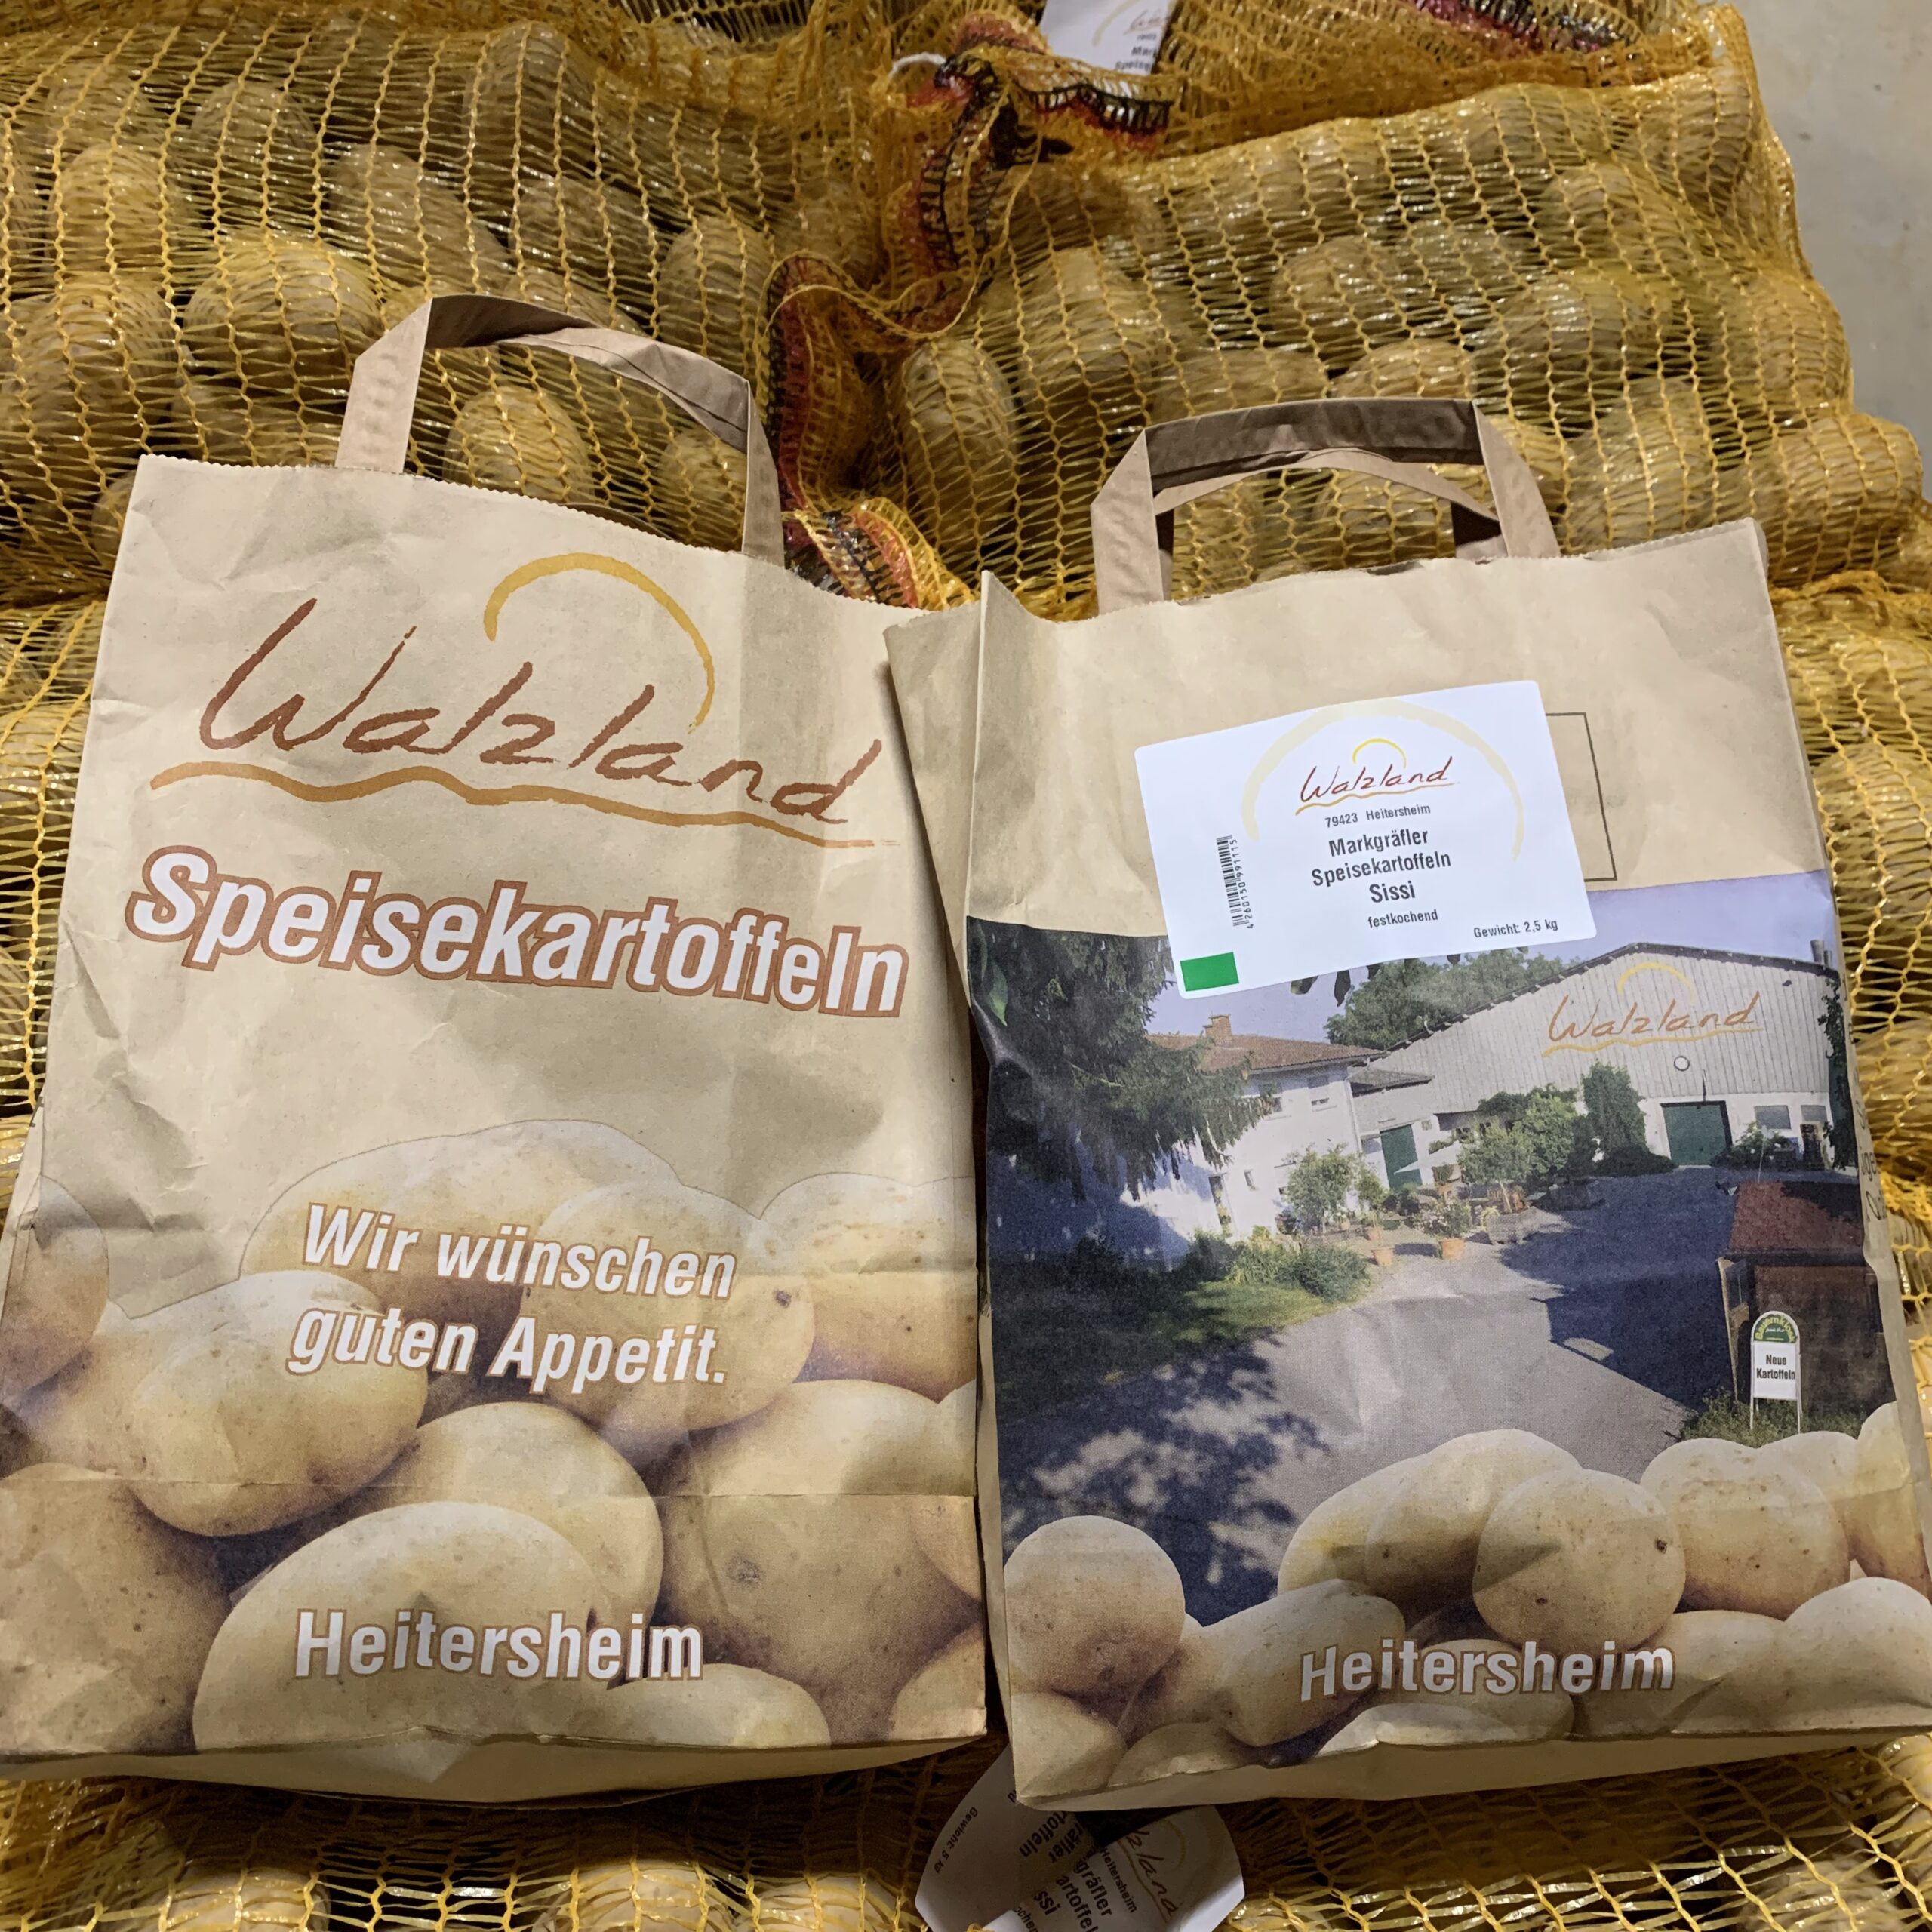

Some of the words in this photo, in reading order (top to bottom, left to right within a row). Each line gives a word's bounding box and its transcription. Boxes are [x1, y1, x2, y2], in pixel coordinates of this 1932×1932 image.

[199, 598, 882, 824] Walzland
[1300, 756, 1452, 803] Walzland
[1324, 812, 1358, 828] 79423
[1366, 804, 1431, 820] Heitersheim
[1328, 829, 1429, 857] Markgräfler
[1312, 851, 1451, 887] Speisekartoffeln
[1369, 881, 1416, 903] Sissi
[128, 845, 908, 1018] Speisekartoffeln
[1367, 909, 1438, 928] festkochend
[1473, 923, 1520, 938] Gewicht:
[1524, 921, 1541, 934] 2,5
[1545, 919, 1558, 931] kg
[1548, 991, 1759, 1041] Walzland
[303, 1202, 420, 1273] Wir
[437, 1223, 737, 1298] wünschen
[287, 1307, 478, 1376] guten
[487, 1315, 727, 1394] Appetit.
[1766, 1355, 1787, 1365] Neue
[1756, 1368, 1795, 1380] Kartoffeln
[294, 1607, 703, 1681] Heitersheim
[1300, 1638, 1676, 1703] Heitersheim
[942, 1850, 949, 1860] 5
